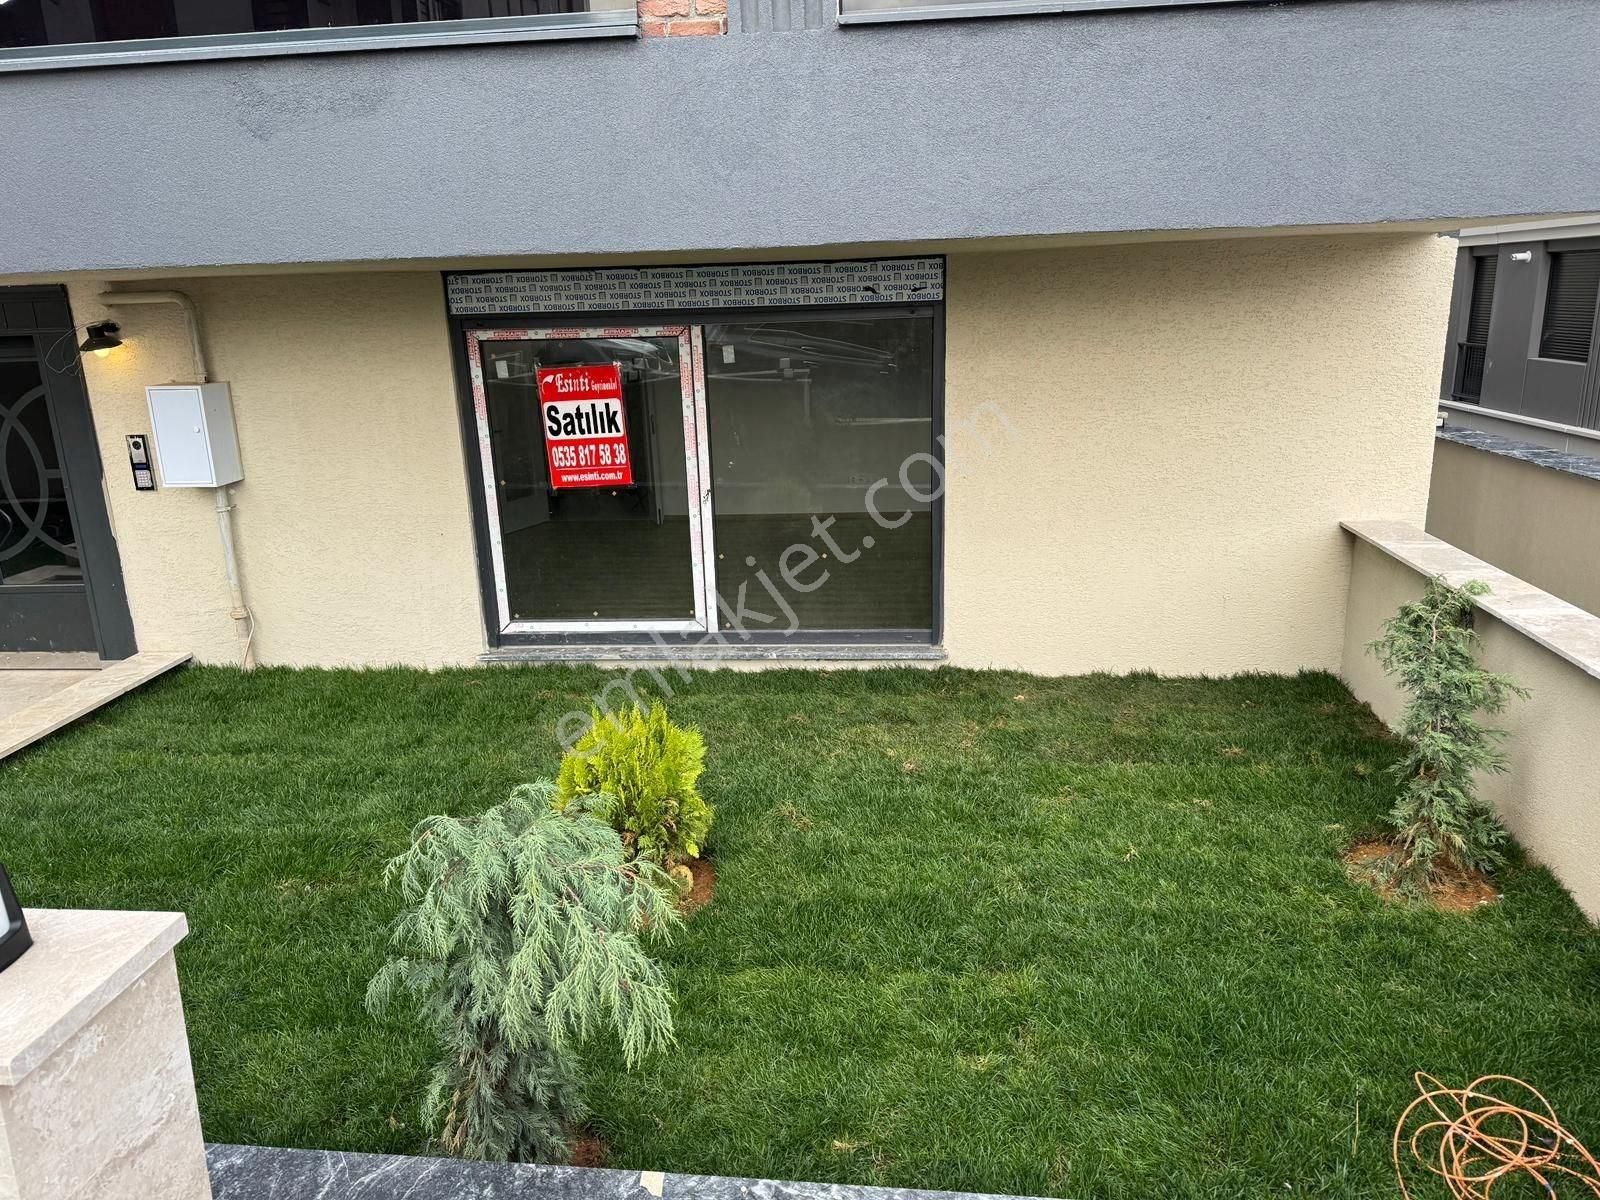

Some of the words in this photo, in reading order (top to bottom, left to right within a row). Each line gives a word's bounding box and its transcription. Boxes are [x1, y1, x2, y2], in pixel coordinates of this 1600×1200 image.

[472, 276, 503, 284] STORBOX
[516, 275, 548, 283] STORBOX
[554, 372, 590, 392] Esinti
[546, 402, 620, 436] Satılık
[552, 446, 576, 467] 0535
[578, 444, 596, 466] 817
[599, 444, 612, 466] 58
[614, 443, 626, 464] 38
[561, 472, 623, 482] www.esinti.com.tr
